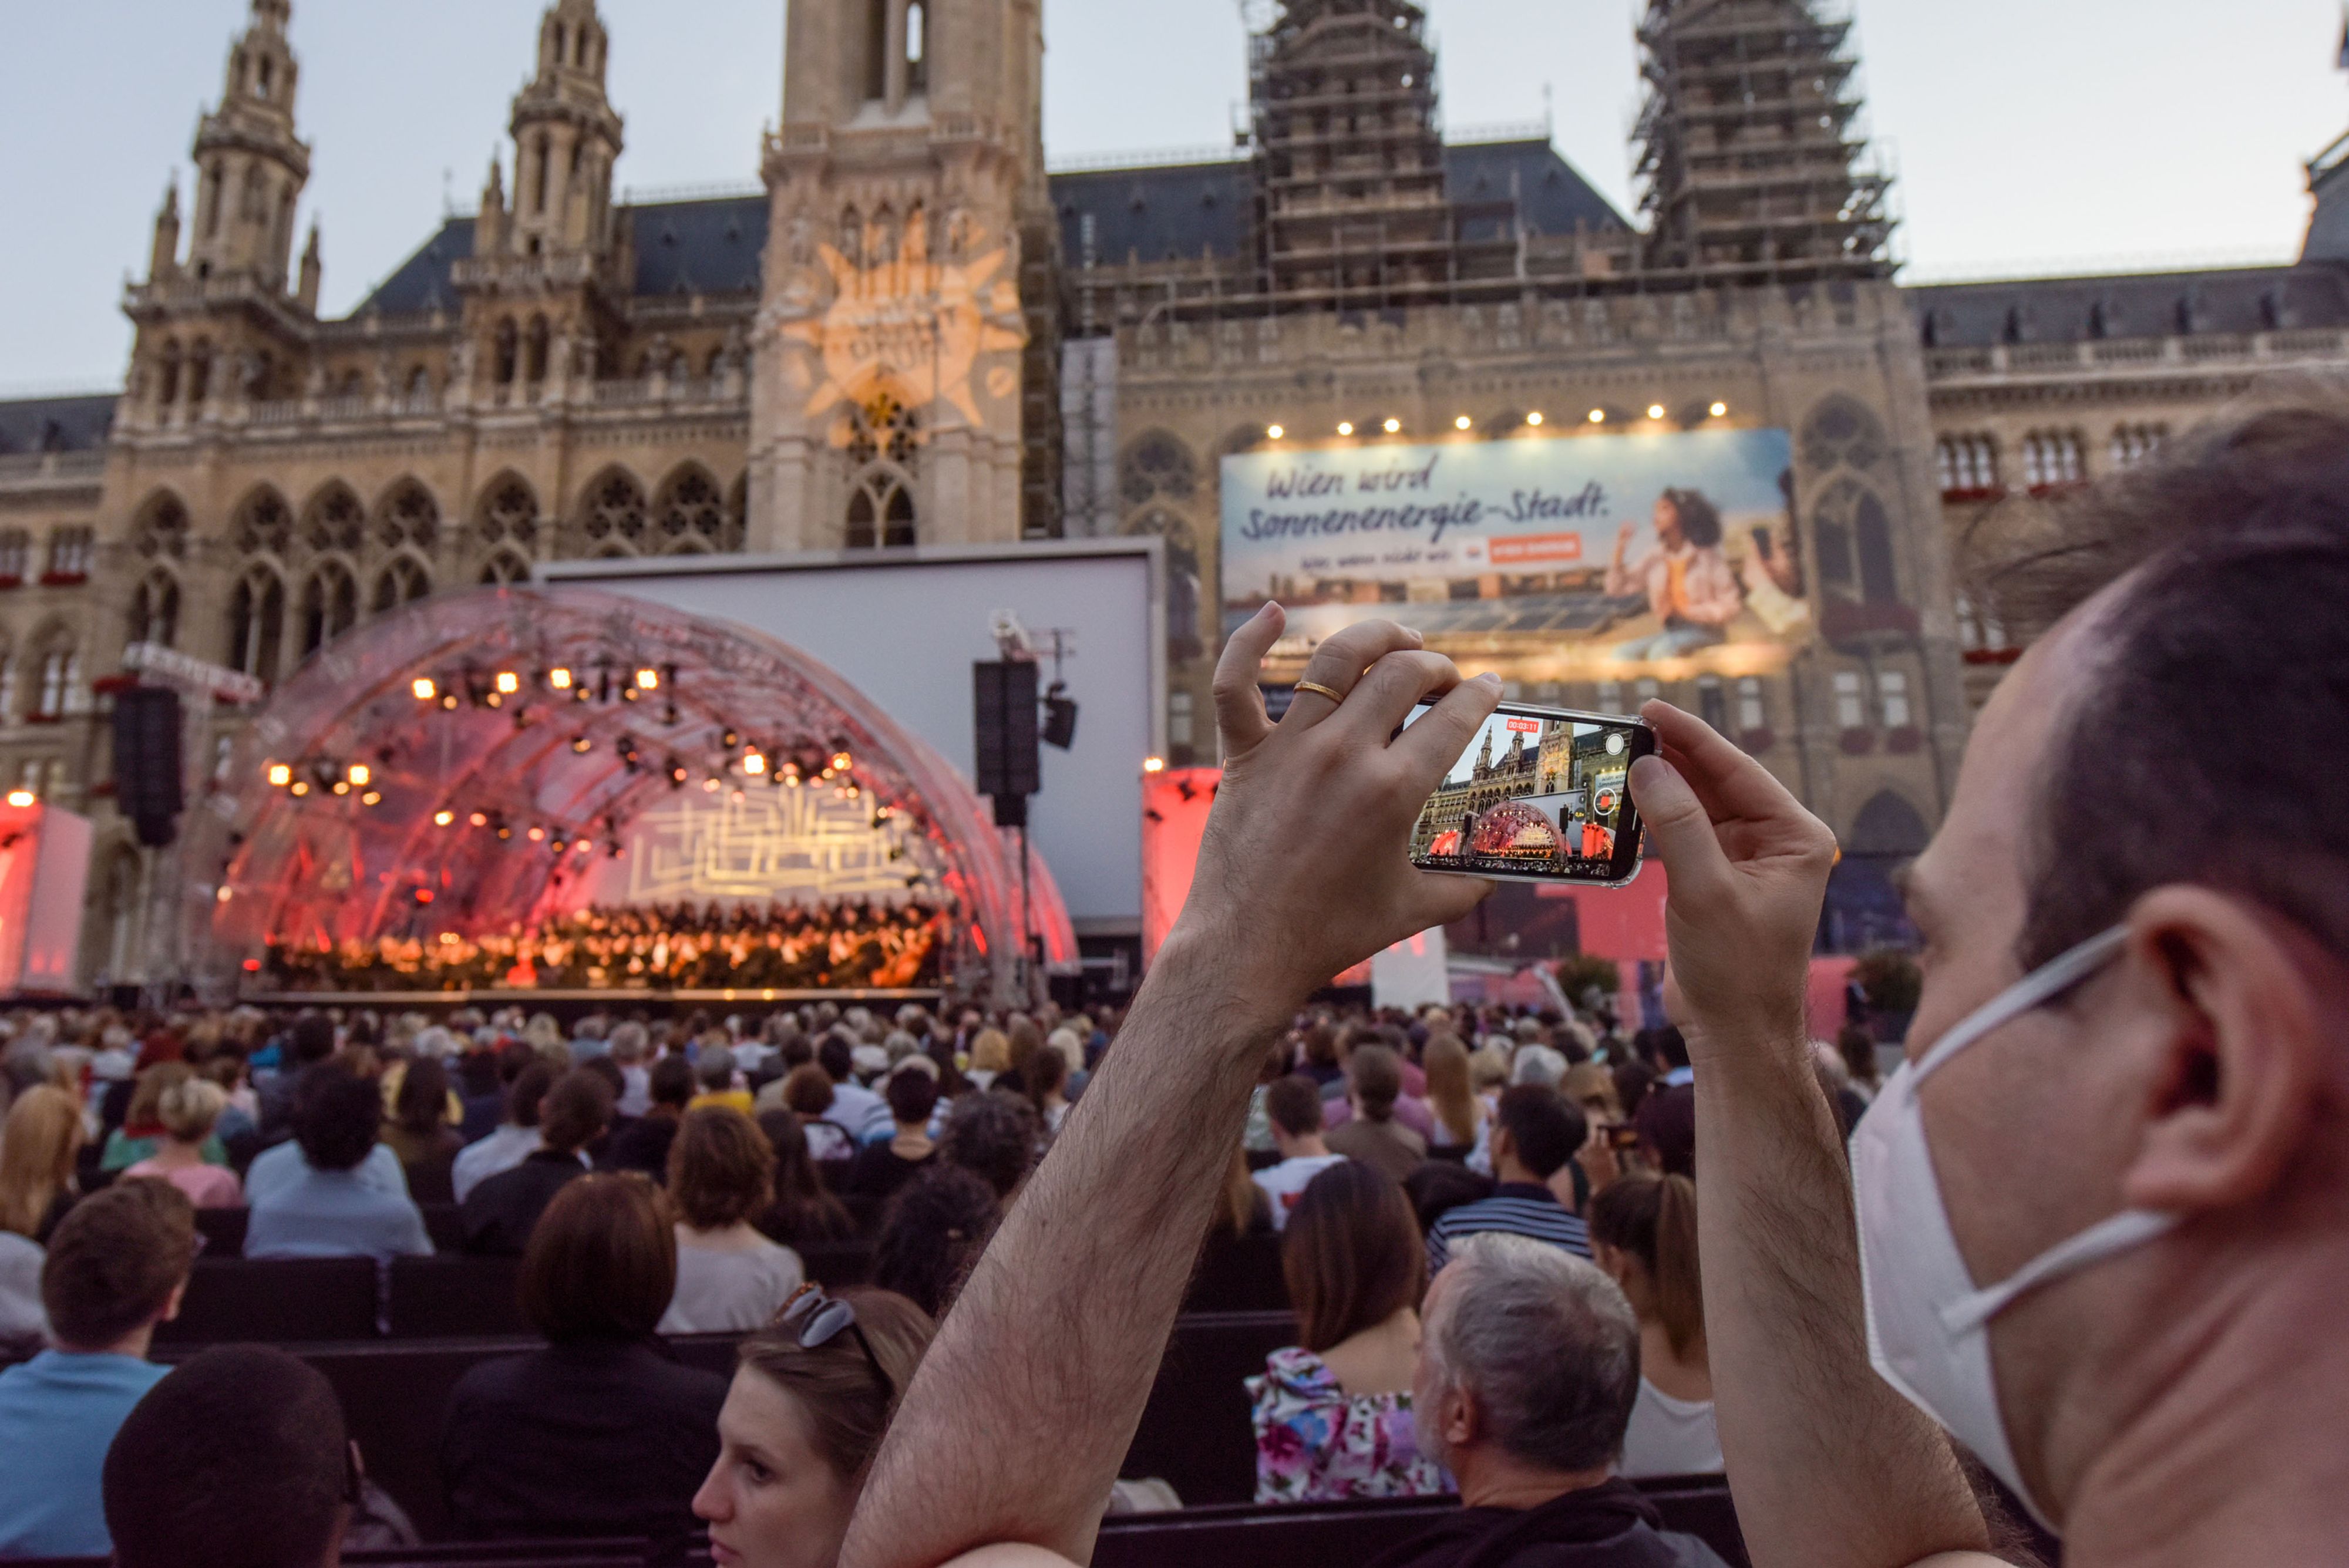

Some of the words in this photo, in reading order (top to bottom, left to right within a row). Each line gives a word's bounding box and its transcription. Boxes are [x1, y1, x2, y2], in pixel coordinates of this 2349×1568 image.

[1266, 463, 1344, 499] Wien
[1358, 451, 1438, 492] wird
[1240, 479, 1609, 544] Sonnenenergie-Stadt.
[1509, 721, 1536, 731] 00:03:11
